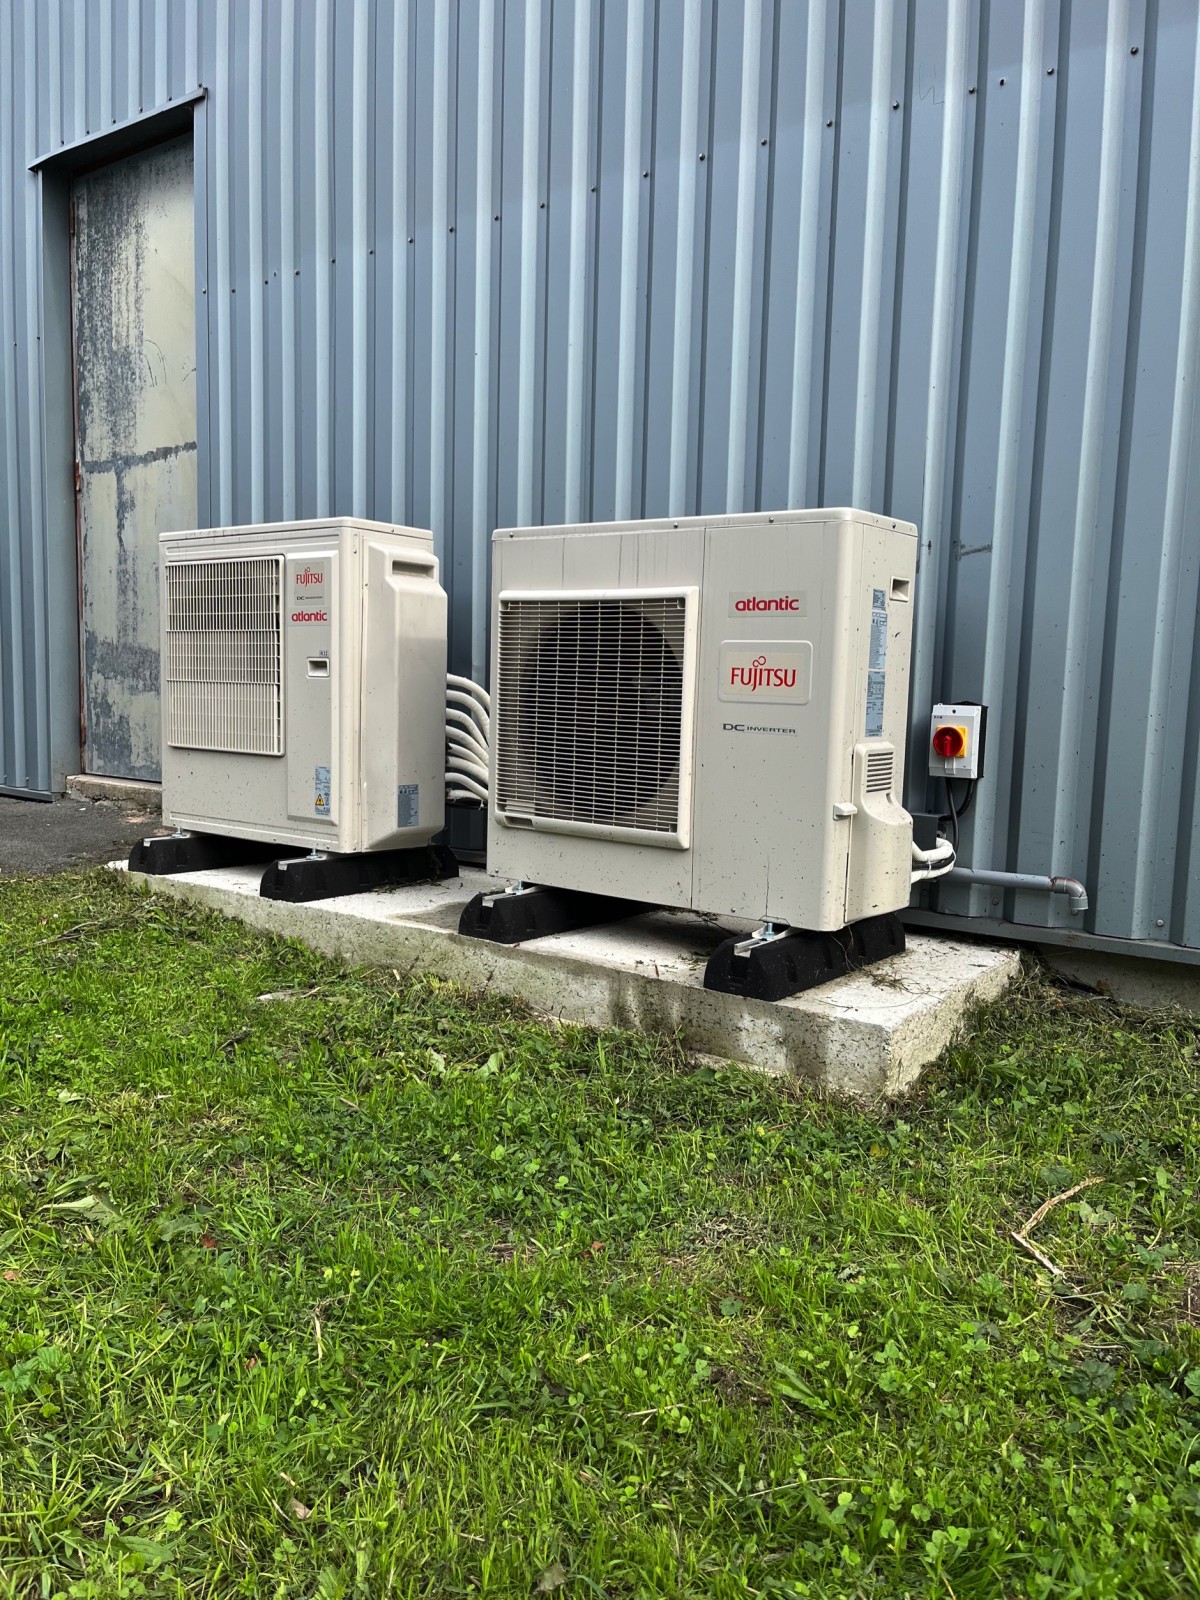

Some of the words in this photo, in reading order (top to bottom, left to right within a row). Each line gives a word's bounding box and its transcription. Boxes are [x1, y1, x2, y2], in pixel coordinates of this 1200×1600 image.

[296, 567, 323, 587] FUJITSU
[735, 596, 800, 612] atlantic
[291, 610, 328, 622] atlantic
[730, 656, 797, 692] FUJITSU
[722, 723, 745, 732] DC
[746, 726, 796, 734] INVERTER
